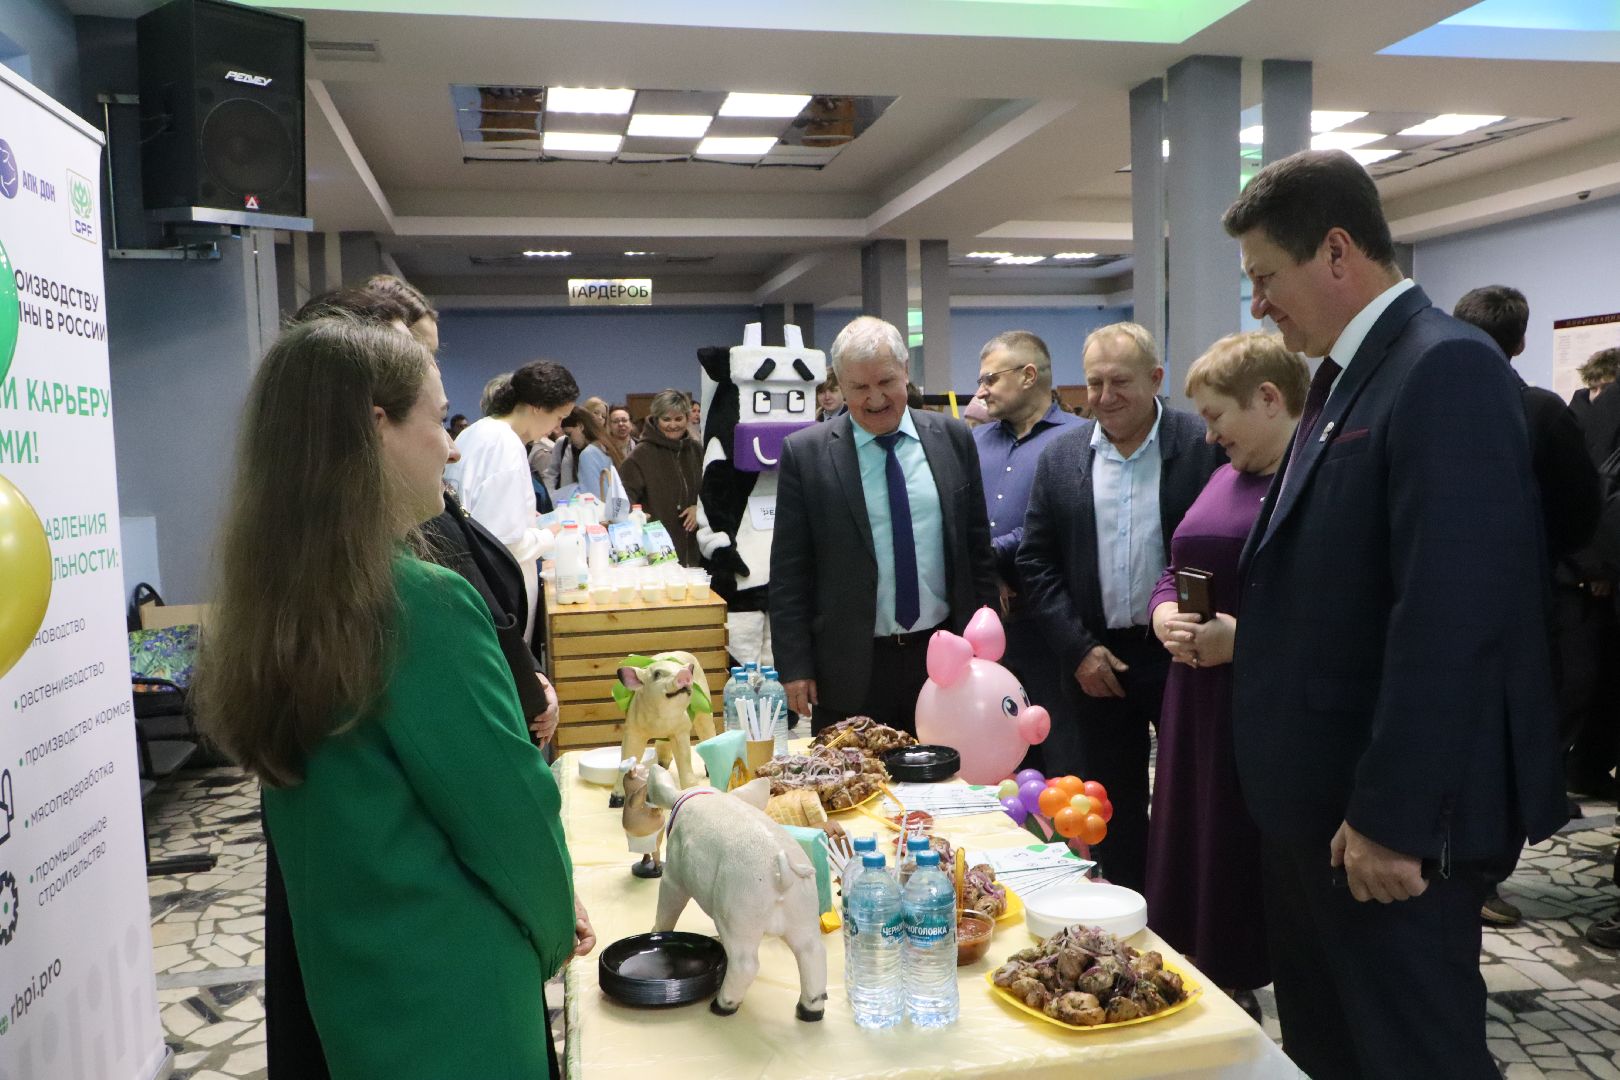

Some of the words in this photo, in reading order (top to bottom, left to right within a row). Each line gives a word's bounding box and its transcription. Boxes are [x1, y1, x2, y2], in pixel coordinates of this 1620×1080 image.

[224, 70, 273, 87] PEAVEY
[22, 170, 38, 194] АПК
[40, 179, 56, 203] ДОН
[14, 269, 99, 313] ОИЗВОДСТВУ
[572, 285, 649, 300] ГАРДЕРОБ
[45, 309, 54, 330] В
[57, 311, 106, 342] РОССИИ
[26, 378, 110, 418] КАРЬЕРУ
[45, 512, 107, 541] АВЛЕНИЯ
[32, 617, 86, 648] НОВОДСТВО
[20, 661, 105, 713] растениеводство
[25, 717, 93, 766] производство
[95, 700, 131, 727] кормов
[30, 761, 114, 827] мясопереработка
[35, 816, 108, 882] промышленное
[38, 841, 106, 906] строительство
[10, 958, 62, 1025] rbpi.pro
